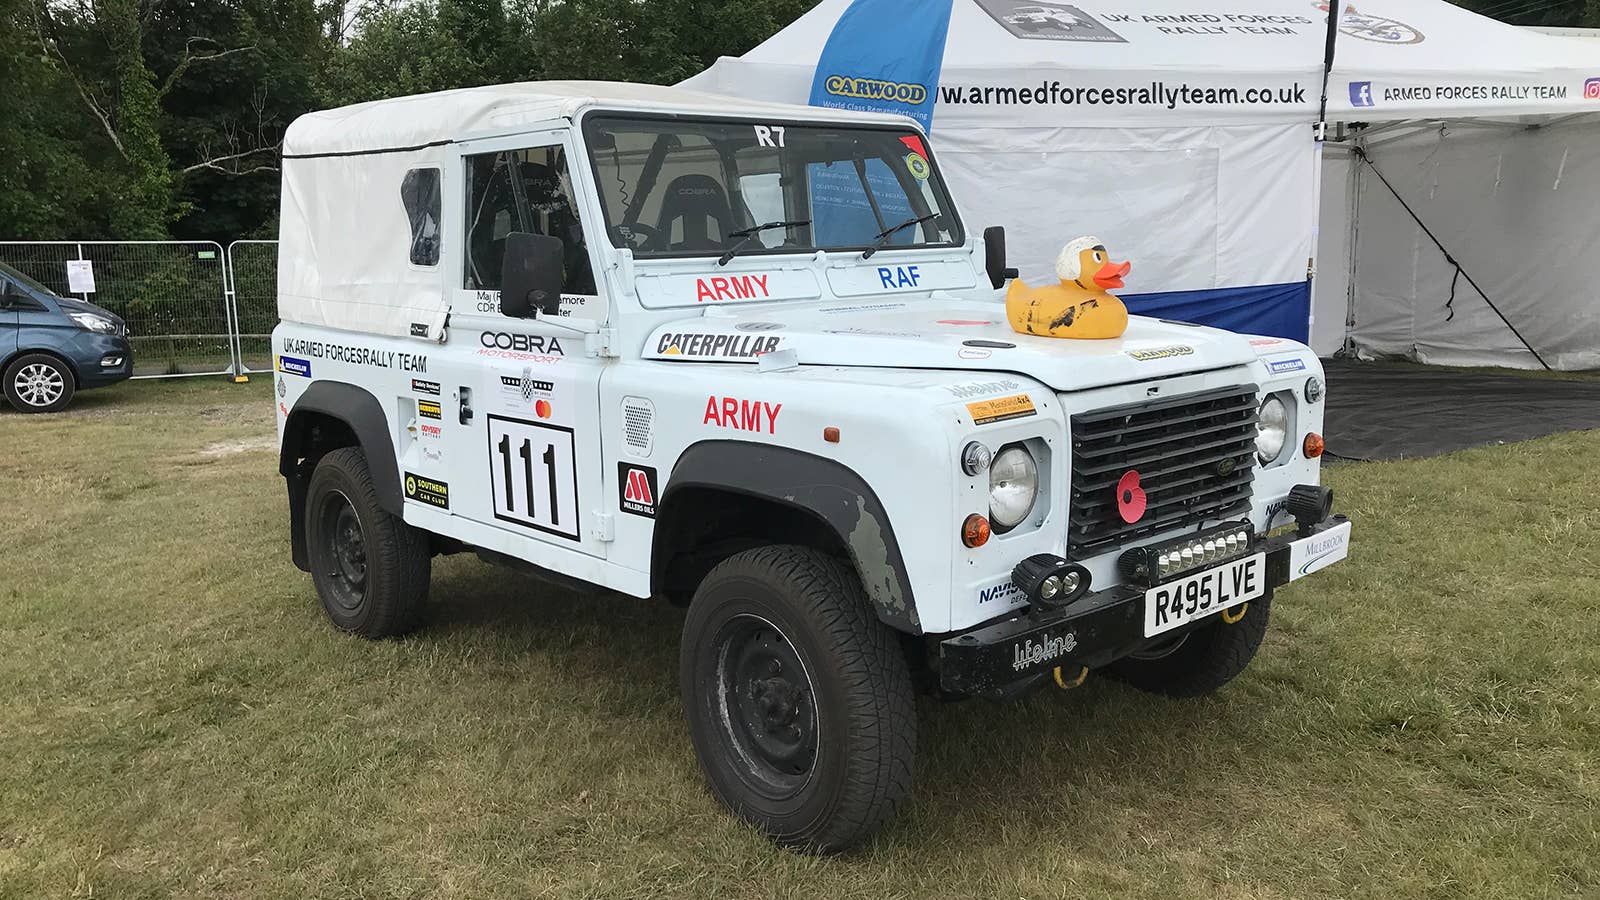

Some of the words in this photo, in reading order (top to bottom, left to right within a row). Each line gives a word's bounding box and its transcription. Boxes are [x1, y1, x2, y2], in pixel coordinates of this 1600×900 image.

[1100, 13, 1137, 23] UK
[1141, 14, 1221, 23] ARMED
[1223, 14, 1312, 24] FORCES
[1157, 26, 1229, 35] RALLY
[1229, 26, 1299, 36] TEAM
[826, 75, 927, 104] CARWOOD
[935, 81, 1306, 109] w.armedforcesrallyteam.co.uk
[1384, 87, 1431, 100] ARMED
[1436, 87, 1487, 99] FORCES
[1492, 87, 1530, 99] RALLY
[1531, 87, 1567, 99] TEAM
[823, 100, 845, 110] World
[847, 101, 866, 112] Class
[753, 125, 786, 148] R7
[877, 265, 921, 289] RAF
[476, 291, 492, 302] Maj
[696, 274, 770, 302] ARMY
[477, 302, 496, 313] CDR
[480, 331, 565, 356] COBRA
[657, 332, 782, 358] CATERPILLAR
[398, 353, 427, 373] TEAM
[477, 349, 563, 364] MOTORSPORT
[1272, 359, 1303, 371] MICHELIN
[703, 395, 783, 434] ARMY
[421, 424, 442, 435] ODYSSEY
[417, 479, 447, 495] SOUTHERN
[498, 433, 559, 526] 111
[420, 493, 431, 501] CAR
[432, 495, 445, 505] CLUB
[623, 501, 644, 513] MILLERS
[644, 506, 655, 515] OILS
[1305, 533, 1344, 558] MILLBROOK
[1155, 574, 1213, 628] R495
[1217, 559, 1257, 604] LVE
[1013, 632, 1078, 672] lifeline
